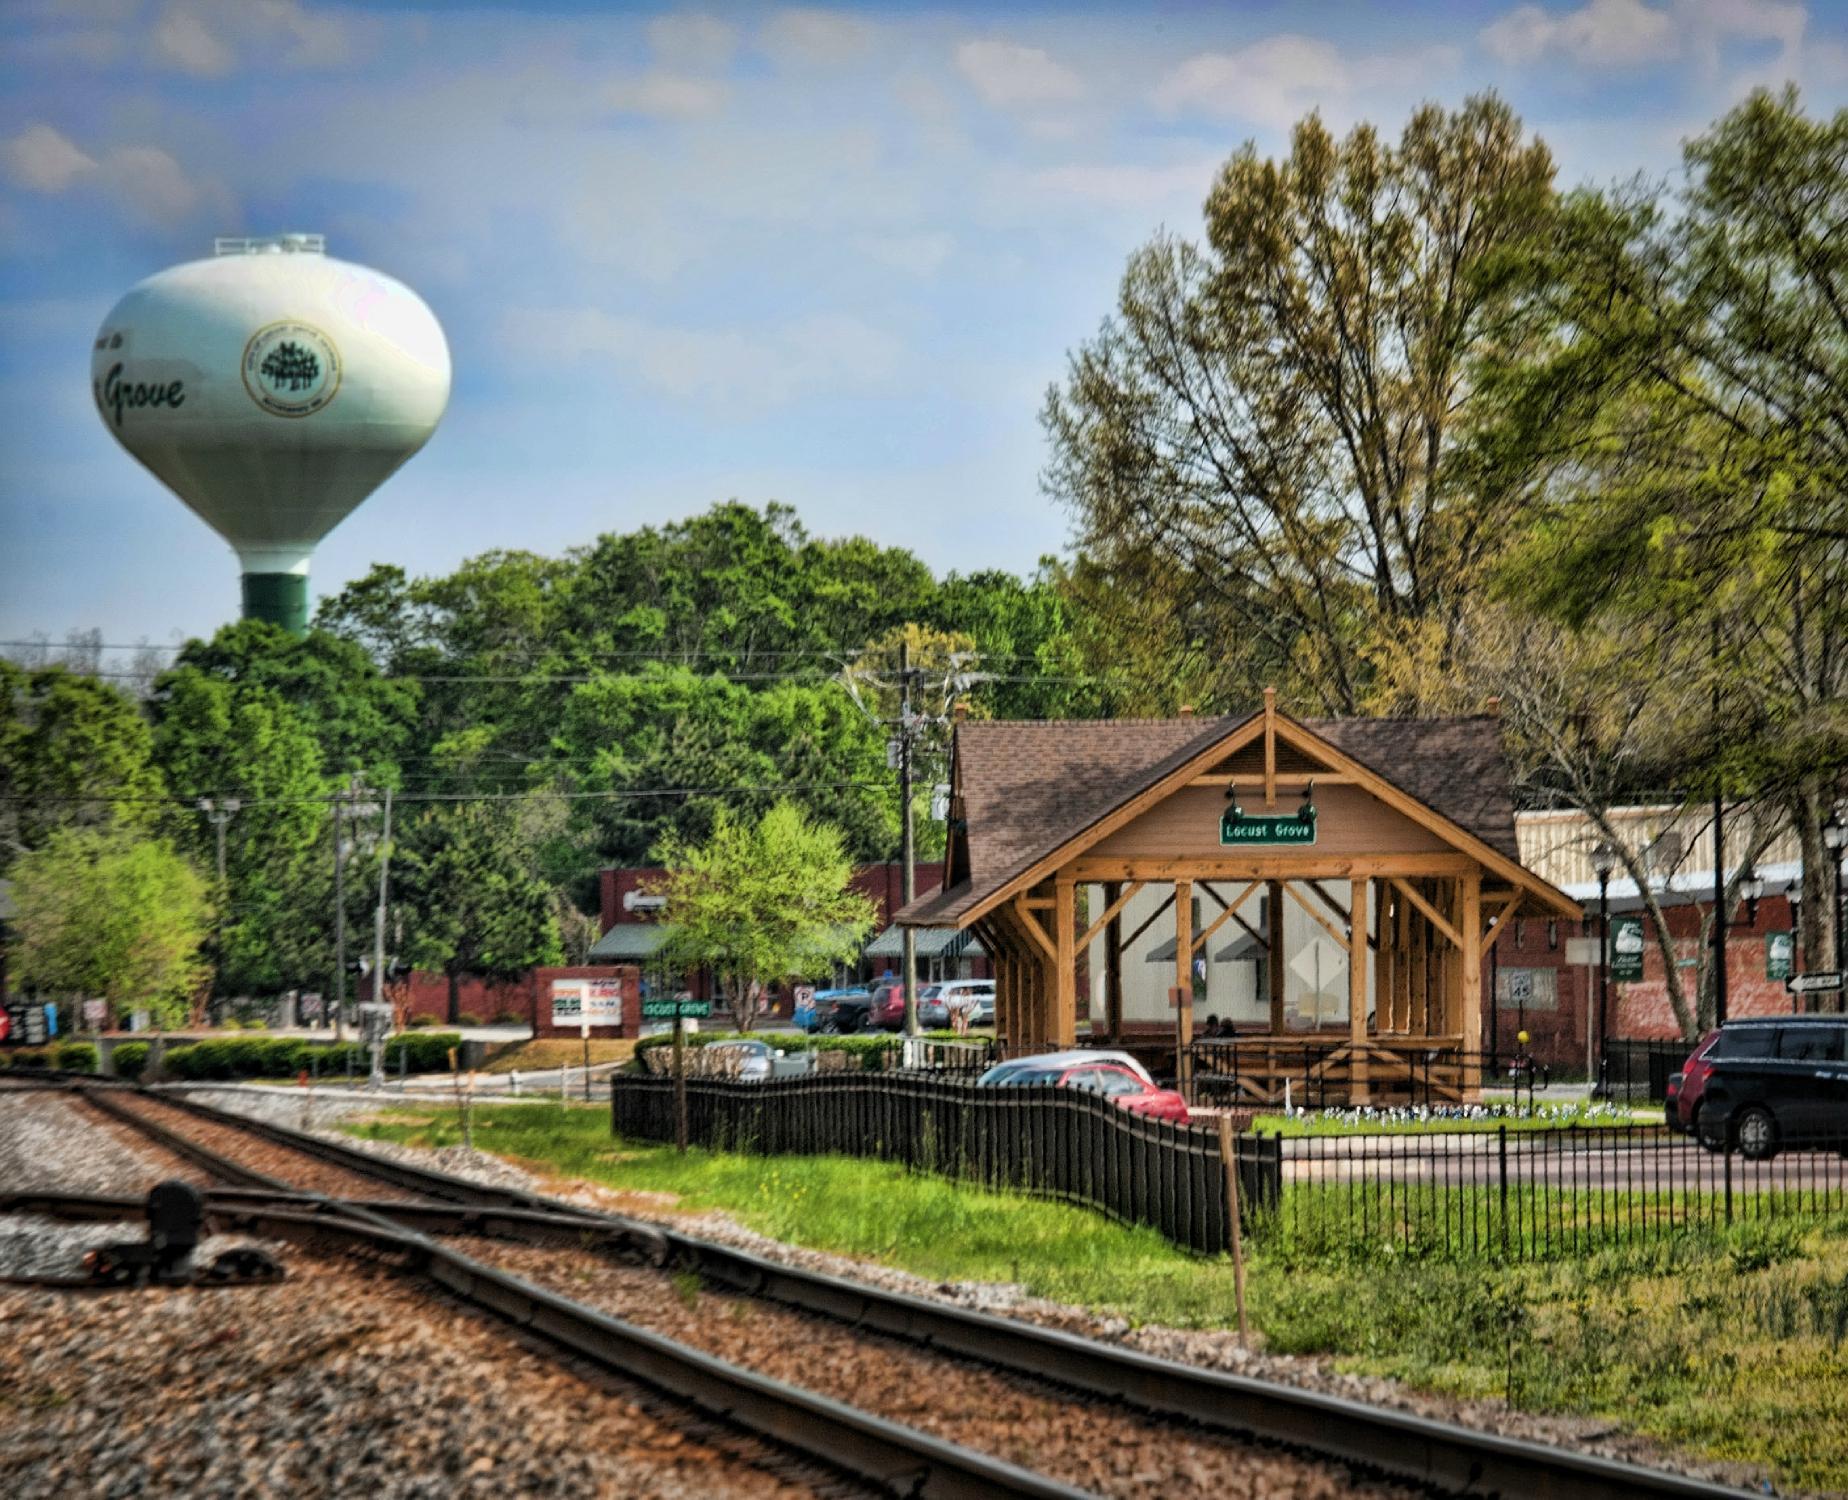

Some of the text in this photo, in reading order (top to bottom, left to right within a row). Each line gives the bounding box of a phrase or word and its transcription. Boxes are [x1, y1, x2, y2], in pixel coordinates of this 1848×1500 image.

[104, 362, 186, 427] Grove
[1226, 824, 1309, 837] Locust Grove
